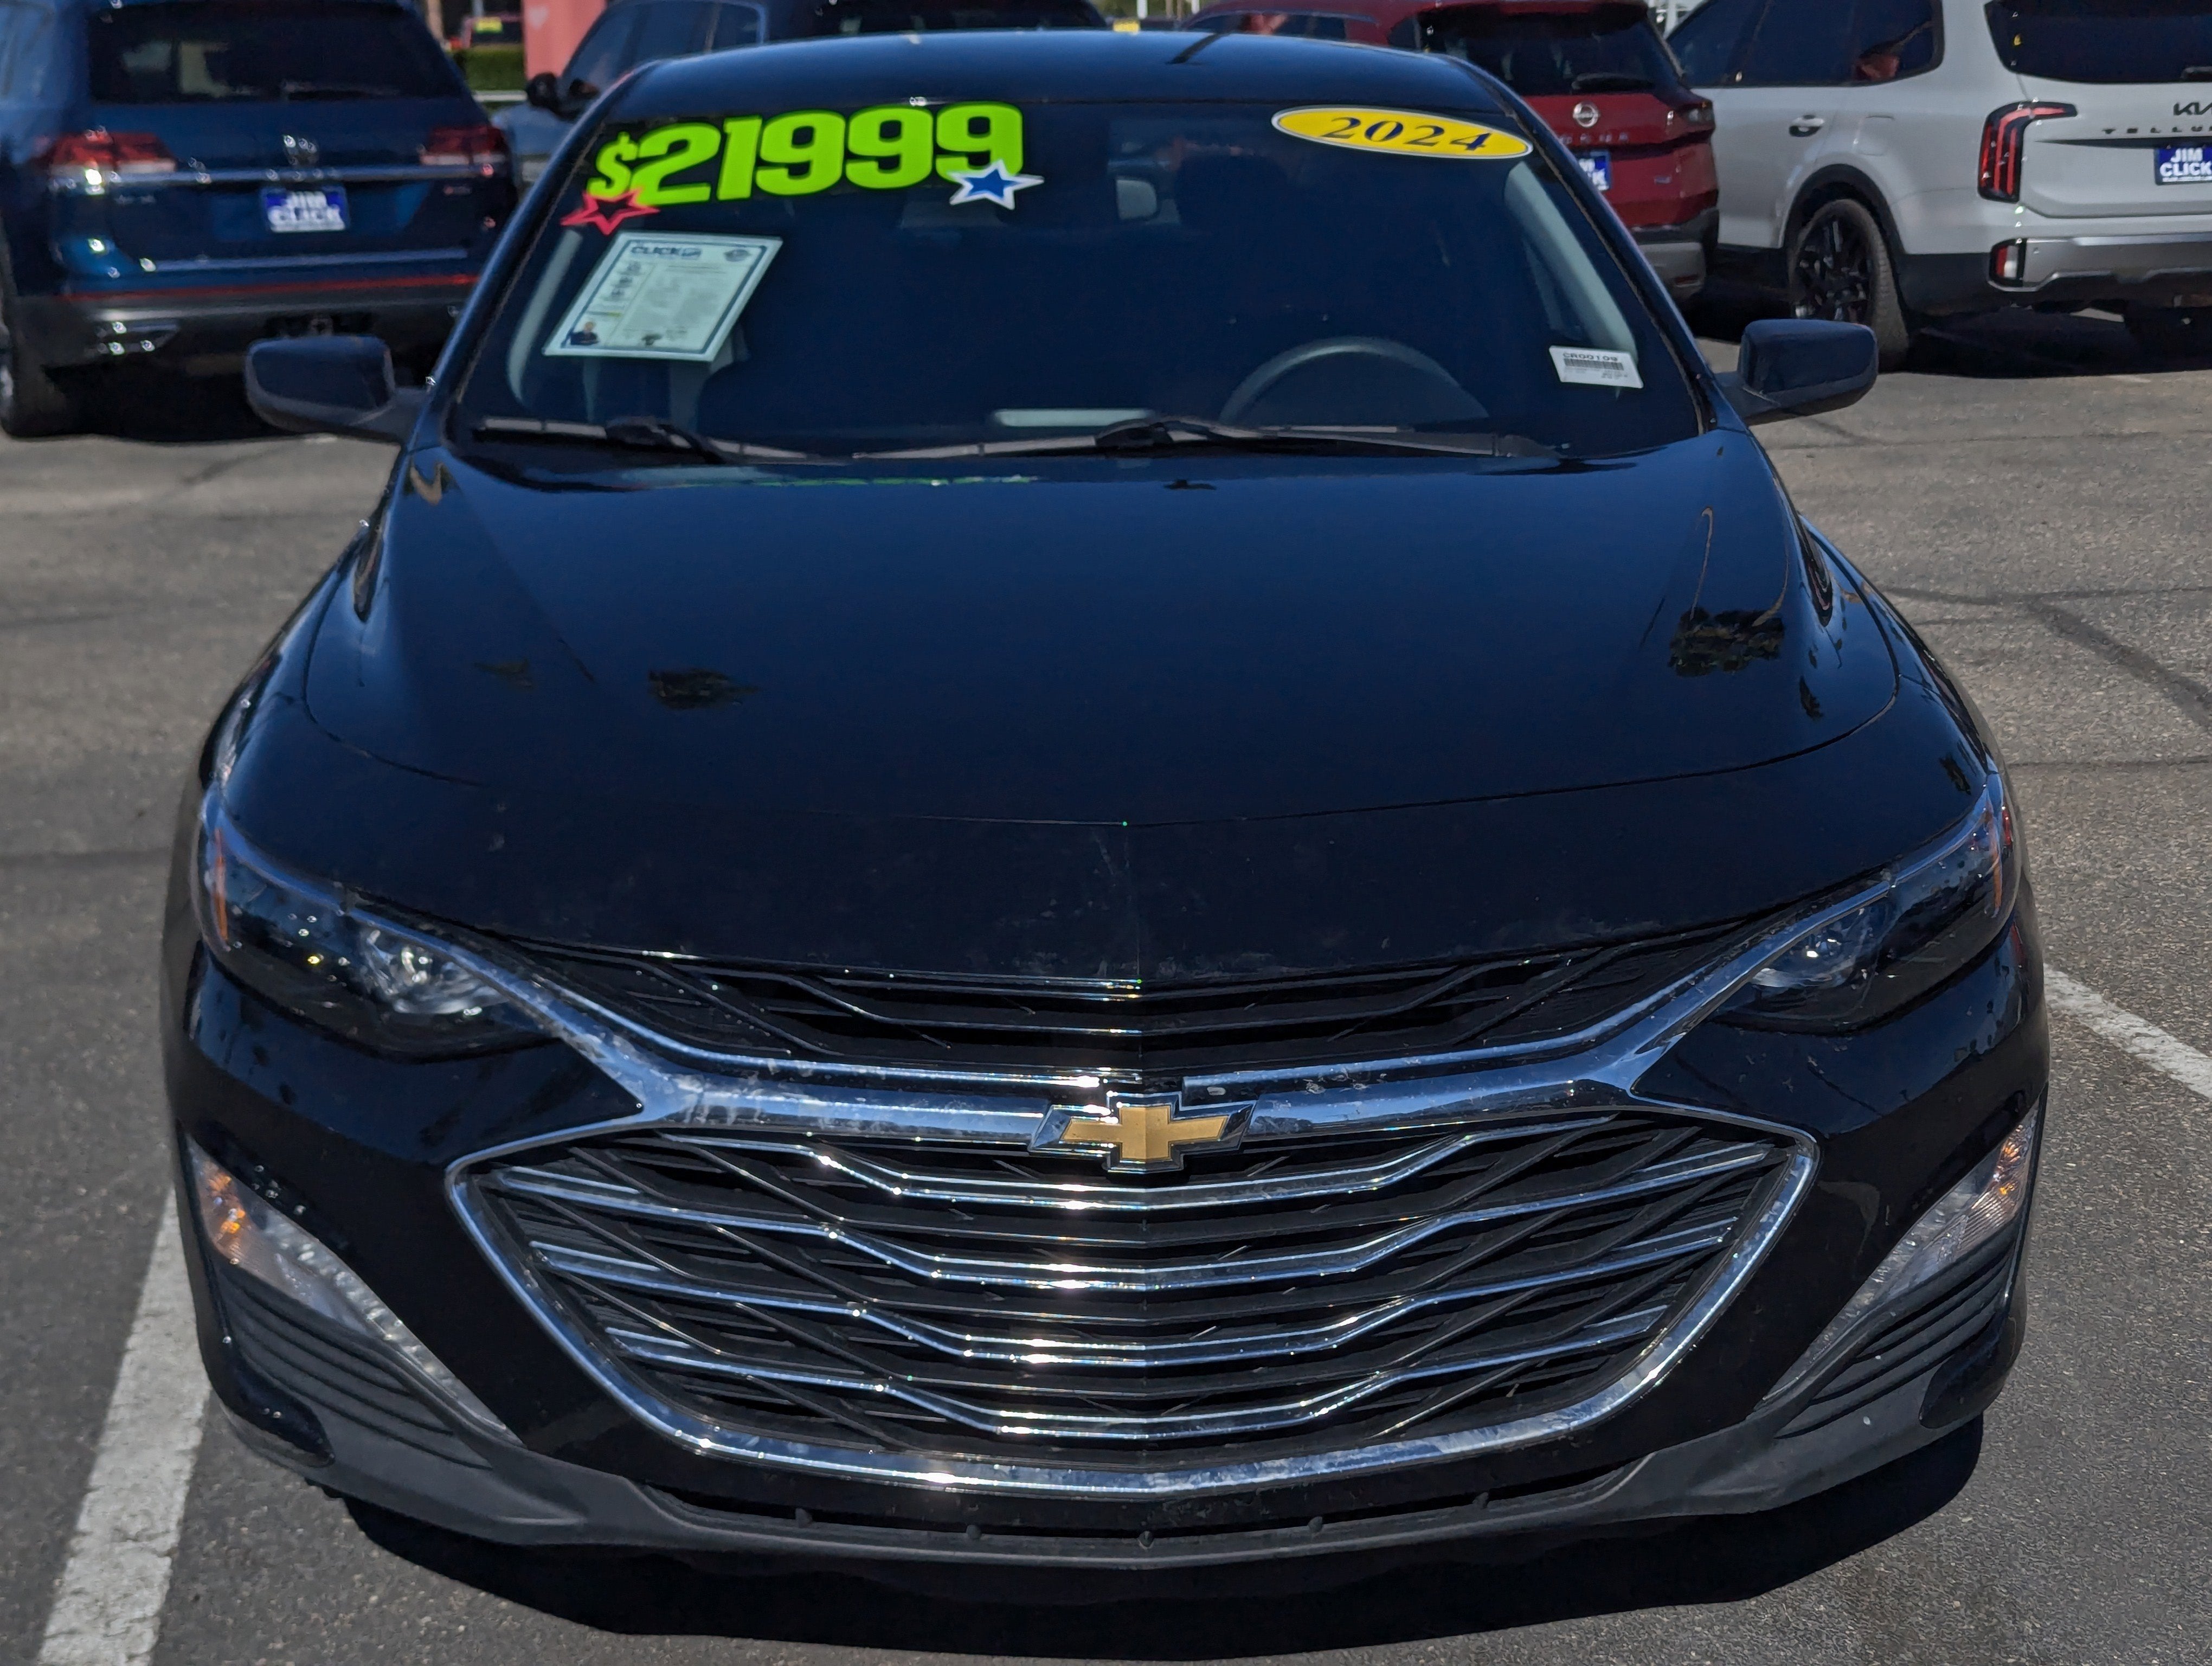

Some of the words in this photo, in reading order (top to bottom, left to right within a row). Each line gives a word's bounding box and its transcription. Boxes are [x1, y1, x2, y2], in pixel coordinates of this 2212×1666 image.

[1320, 116, 1493, 151] 2024
[2102, 125, 2212, 134] TELLU
[586, 102, 1024, 205] $21999
[2170, 148, 2203, 162] JIM
[2160, 161, 2212, 177] CLICK
